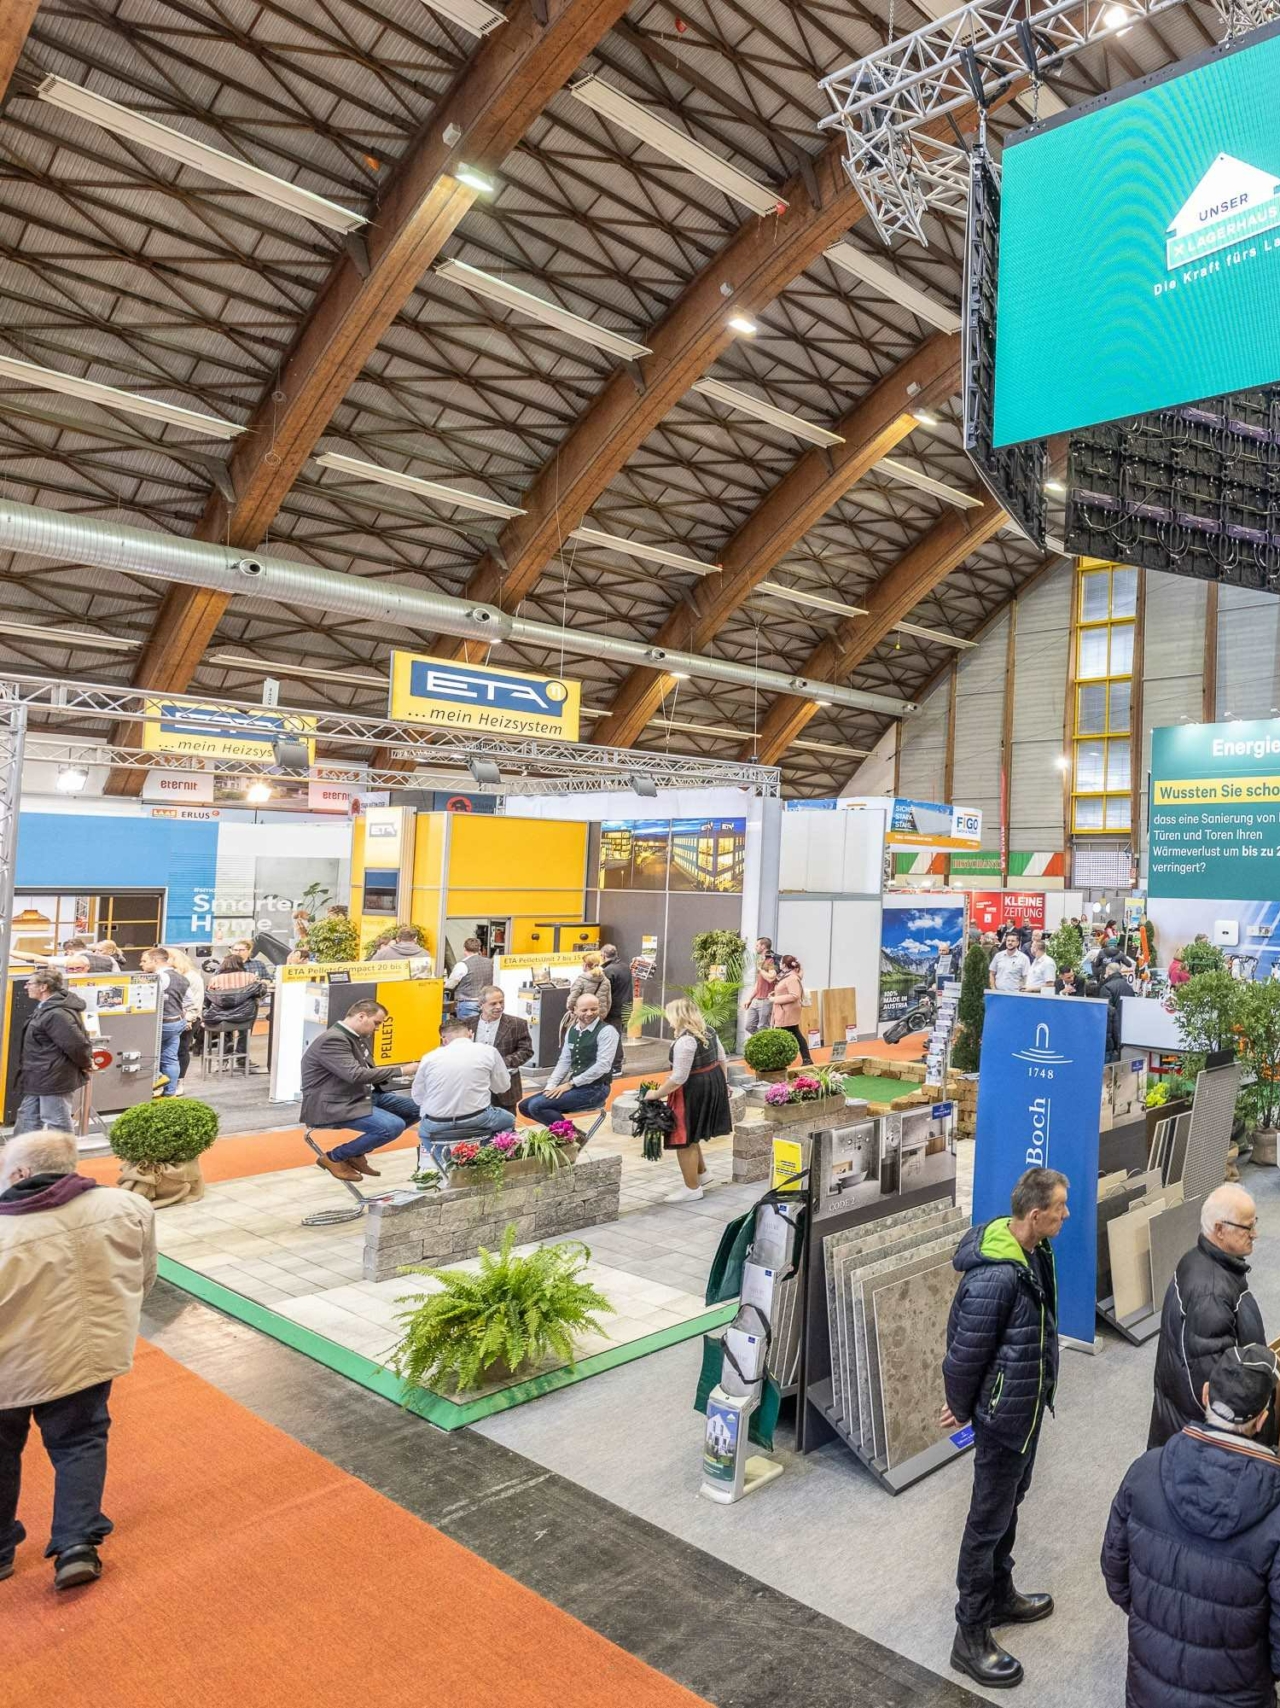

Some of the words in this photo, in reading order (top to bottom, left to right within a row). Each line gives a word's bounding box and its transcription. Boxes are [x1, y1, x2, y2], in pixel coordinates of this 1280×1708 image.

[1199, 193, 1249, 221] UNSER
[1188, 206, 1278, 252] LAGERHAUS
[1154, 278, 1177, 296] Die
[1183, 261, 1221, 284] Kraft
[1226, 247, 1257, 266] fürs
[426, 670, 549, 709] ETA
[479, 713, 563, 735] Heizsystem
[1160, 785, 1217, 800] Wussten
[1221, 784, 1243, 797] Sie
[181, 811, 210, 820] ERLUS
[1154, 813, 1177, 825] dass
[1178, 812, 1199, 824] eine
[1201, 811, 1254, 826] Sanierung
[1256, 813, 1276, 823] von
[957, 816, 979, 830] FIGO
[1154, 828, 1181, 841] Türen
[1183, 829, 1202, 840] und
[1205, 829, 1234, 840] Toren
[1236, 829, 1263, 840] Ihren
[1153, 845, 1221, 857] Wärmeverlust
[1223, 848, 1239, 857] um
[1242, 846, 1258, 857] bis
[1260, 848, 1274, 857] zu
[1152, 861, 1206, 874] verringert?
[193, 894, 303, 912] Smarter
[1004, 896, 1043, 907] KLEINE
[1004, 907, 1043, 918] ZEITUNG
[390, 962, 401, 970] bis
[883, 1002, 908, 1010] AUSTRIA
[381, 1016, 394, 1059] PELLETS
[1028, 1067, 1054, 1079] 1748
[1026, 1097, 1046, 1168] Boch
